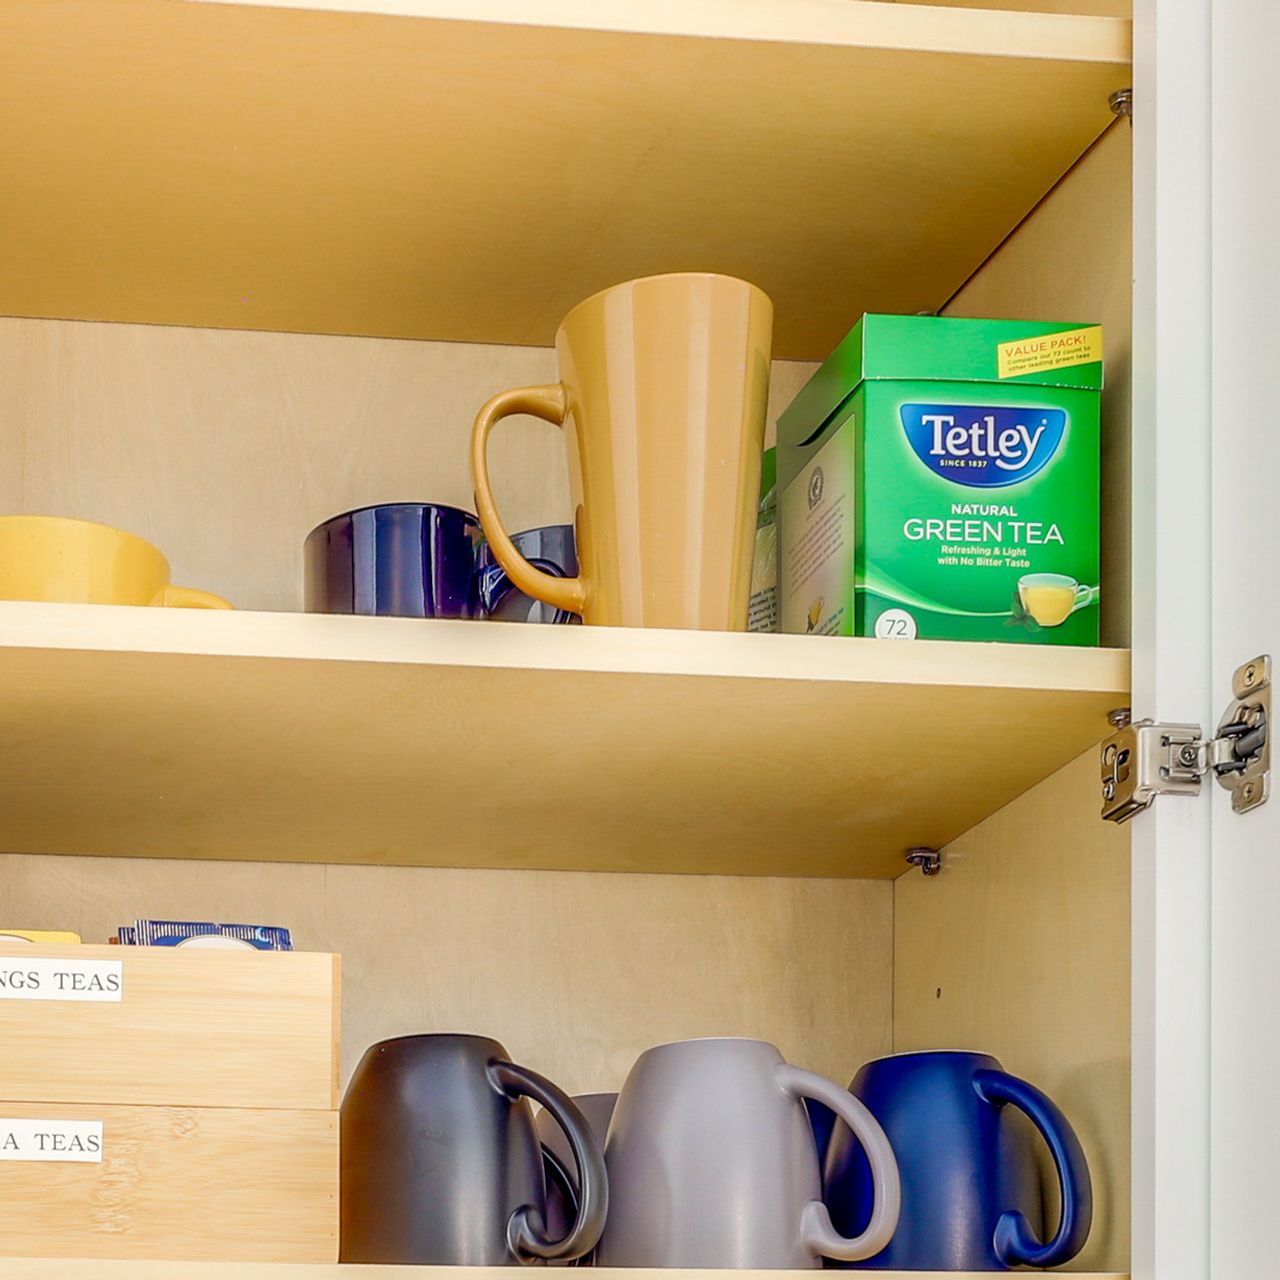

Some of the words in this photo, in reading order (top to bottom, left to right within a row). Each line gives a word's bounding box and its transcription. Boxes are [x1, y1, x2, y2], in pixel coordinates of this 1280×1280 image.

[1005, 342, 1046, 357] VALUE
[1051, 335, 1086, 349] PACK!
[921, 415, 1046, 470] Tetley
[940, 459, 965, 467] SINCE
[969, 460, 987, 468] 1837
[951, 504, 1017, 516] NATURAL
[903, 518, 1002, 542] GREEN
[1008, 522, 1064, 545] TEA
[941, 545, 990, 556] Refreshing
[995, 547, 1000, 555] &
[1003, 547, 1026, 557] Light
[938, 557, 957, 565] with
[976, 558, 1002, 566] Bitter
[1005, 558, 1030, 567] Taste
[885, 619, 907, 635] 72
[54, 972, 120, 992] TEAS
[34, 1132, 100, 1152] TEAS
